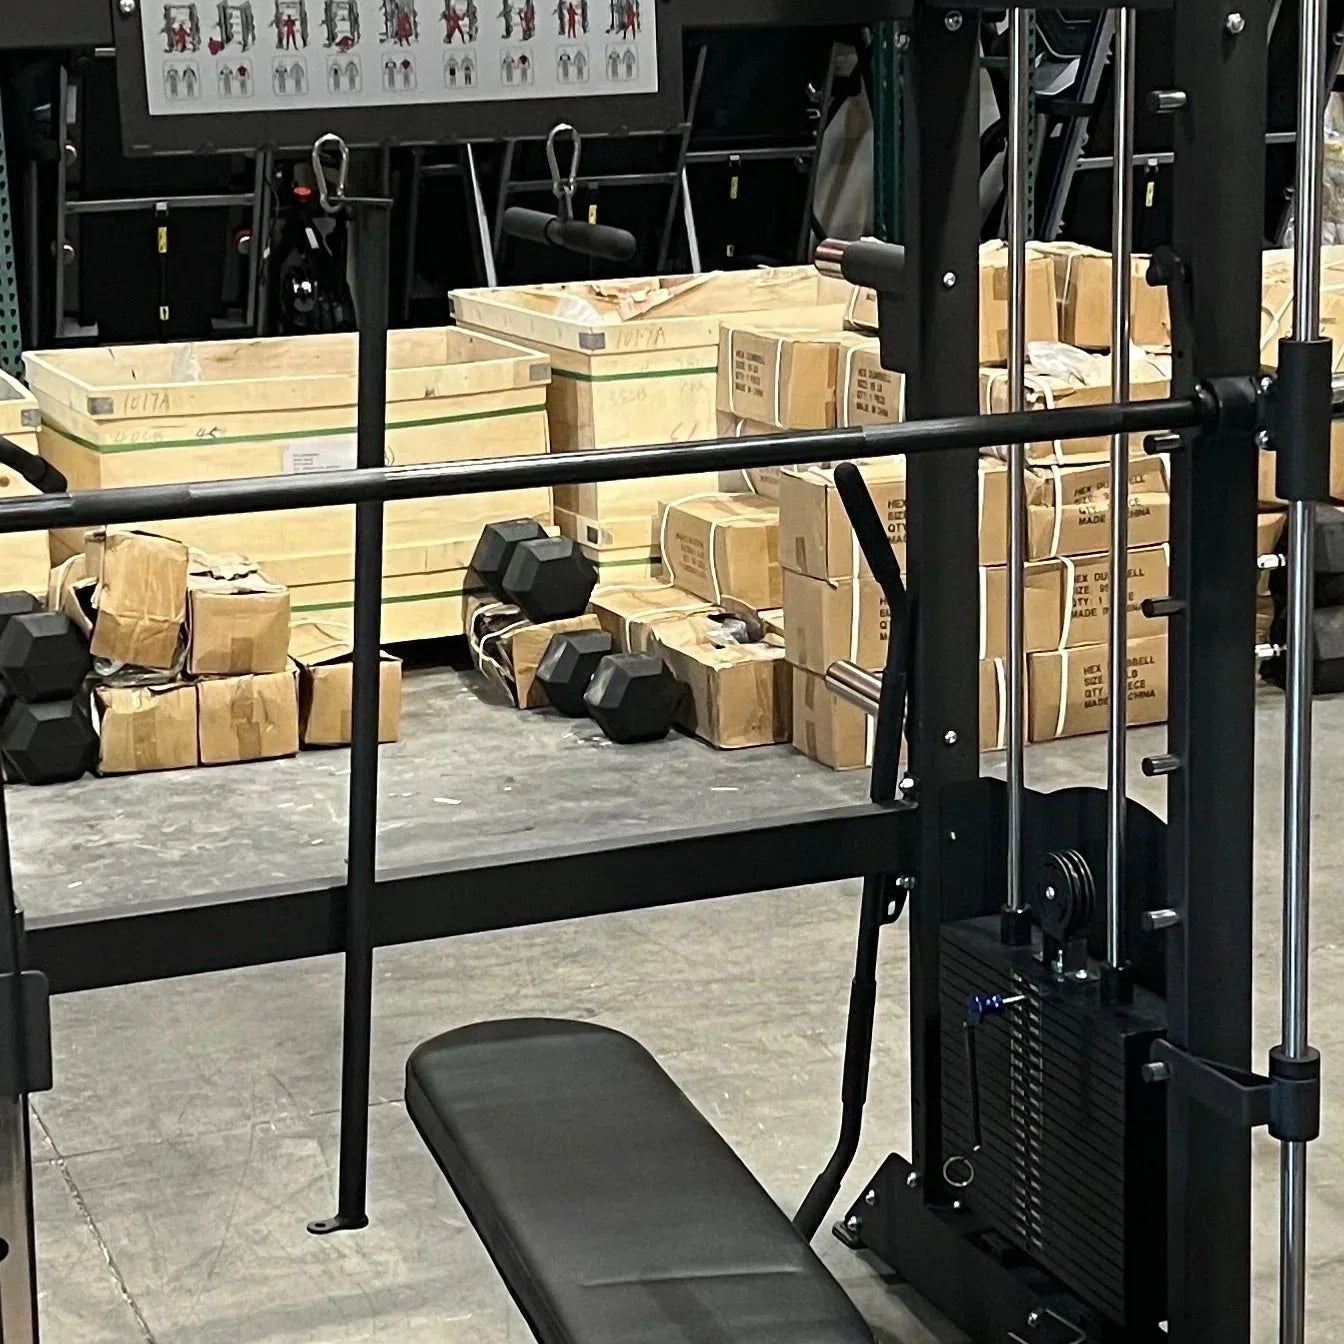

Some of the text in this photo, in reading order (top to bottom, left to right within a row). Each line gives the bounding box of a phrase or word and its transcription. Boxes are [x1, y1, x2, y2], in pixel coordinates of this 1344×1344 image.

[1083, 664, 1102, 676] HEX
[1083, 675, 1104, 687] SIZE
[1083, 697, 1110, 709] MADE
